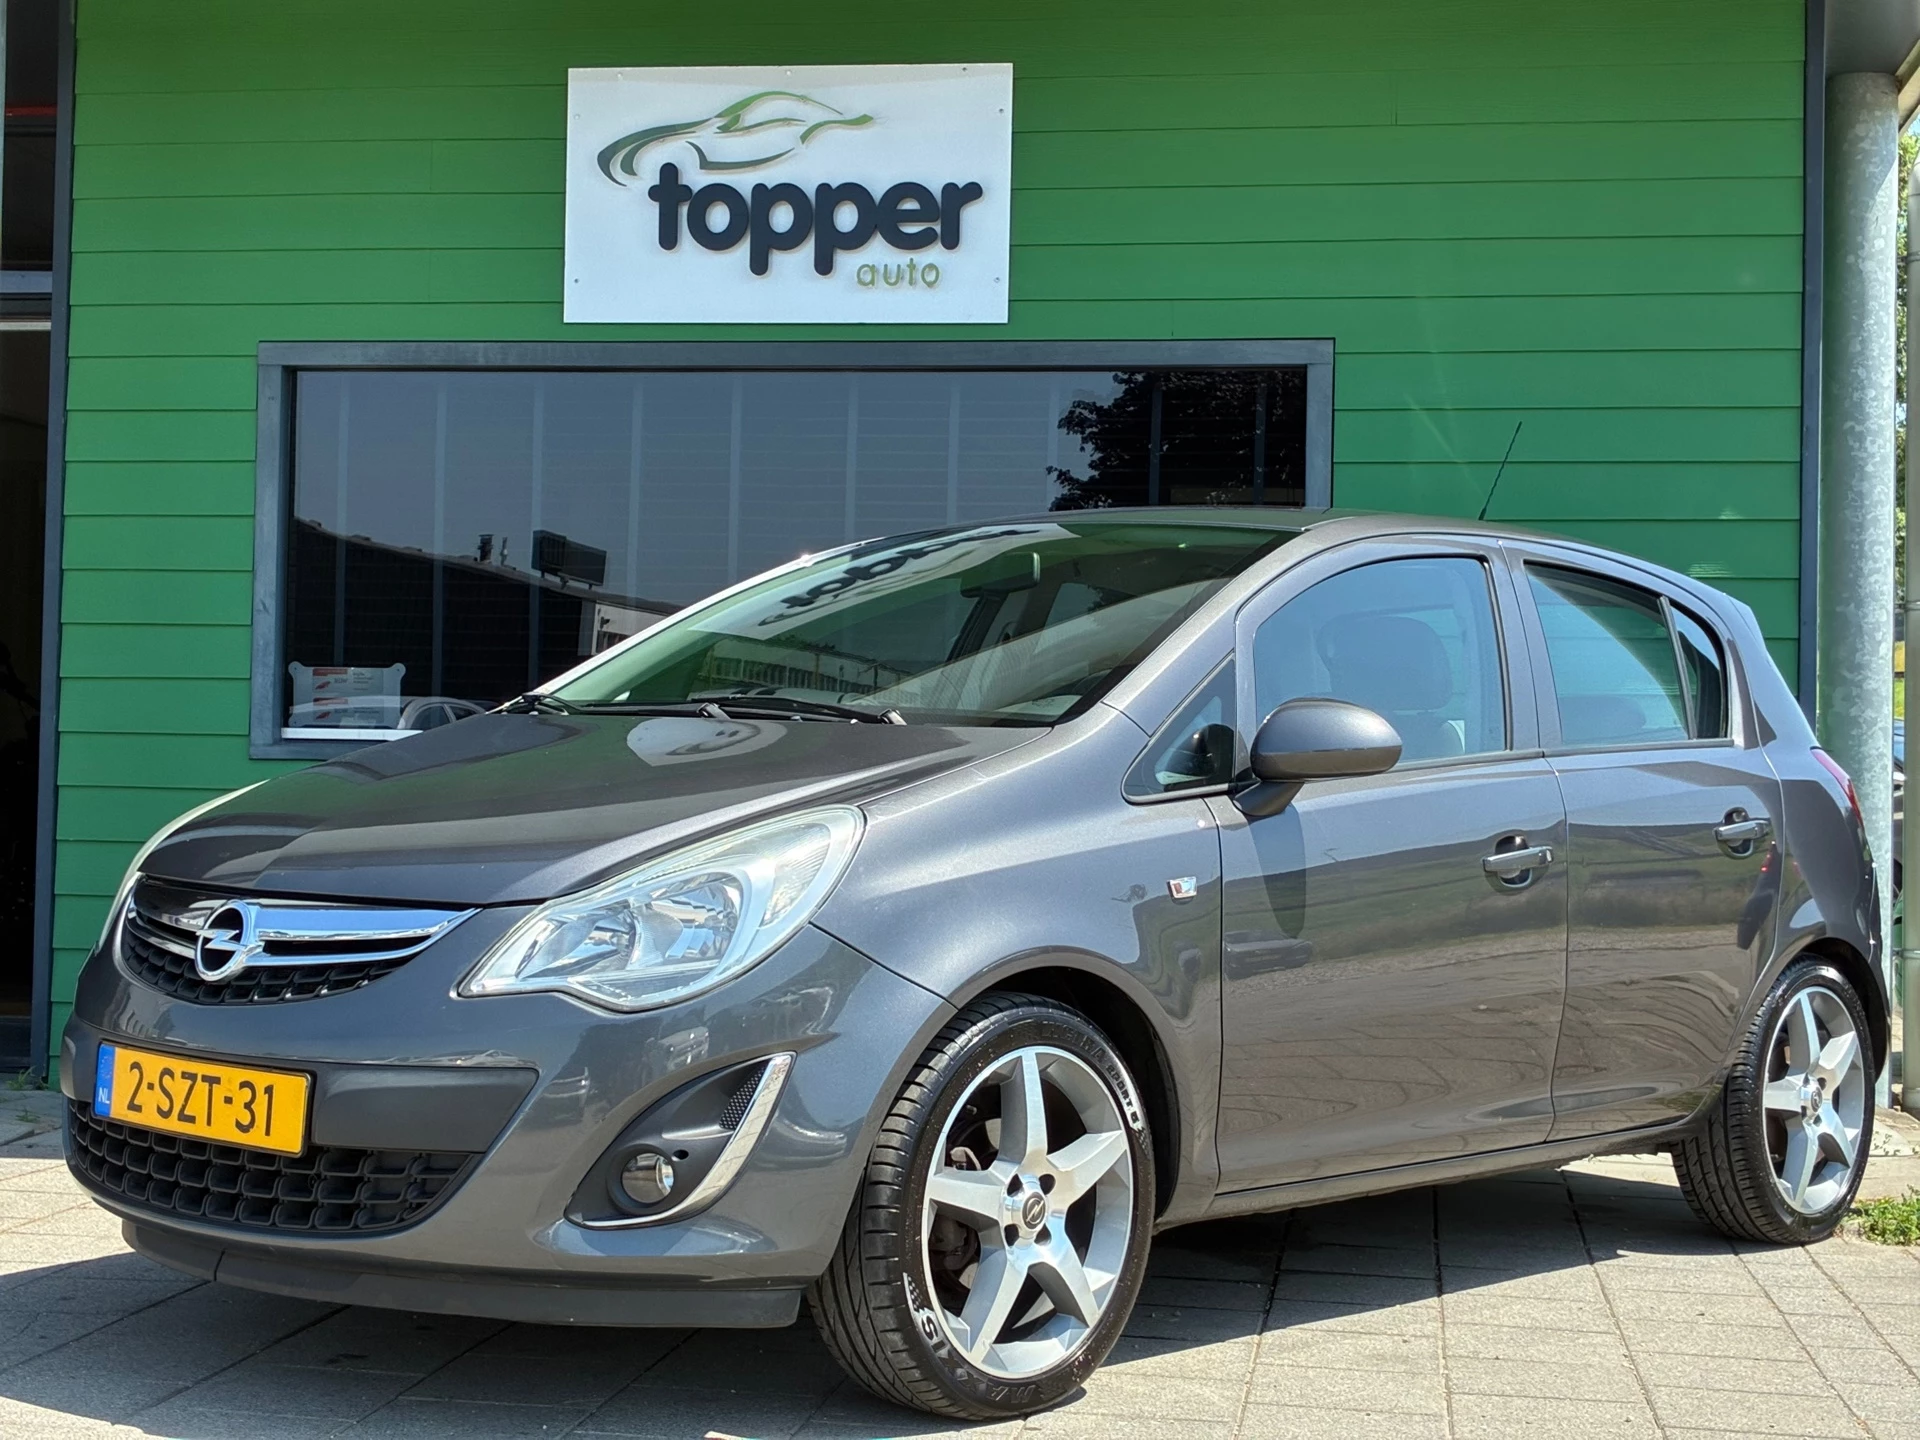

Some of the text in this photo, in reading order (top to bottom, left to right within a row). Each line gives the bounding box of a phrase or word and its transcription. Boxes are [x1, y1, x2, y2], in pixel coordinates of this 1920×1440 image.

[647, 161, 983, 277] topper
[856, 257, 940, 288] auto
[98, 1087, 110, 1104] NL
[126, 1061, 274, 1137] 2-SZT-31
[1106, 1064, 1134, 1108] SPORT
[921, 1315, 1036, 1404] MAXXIS
